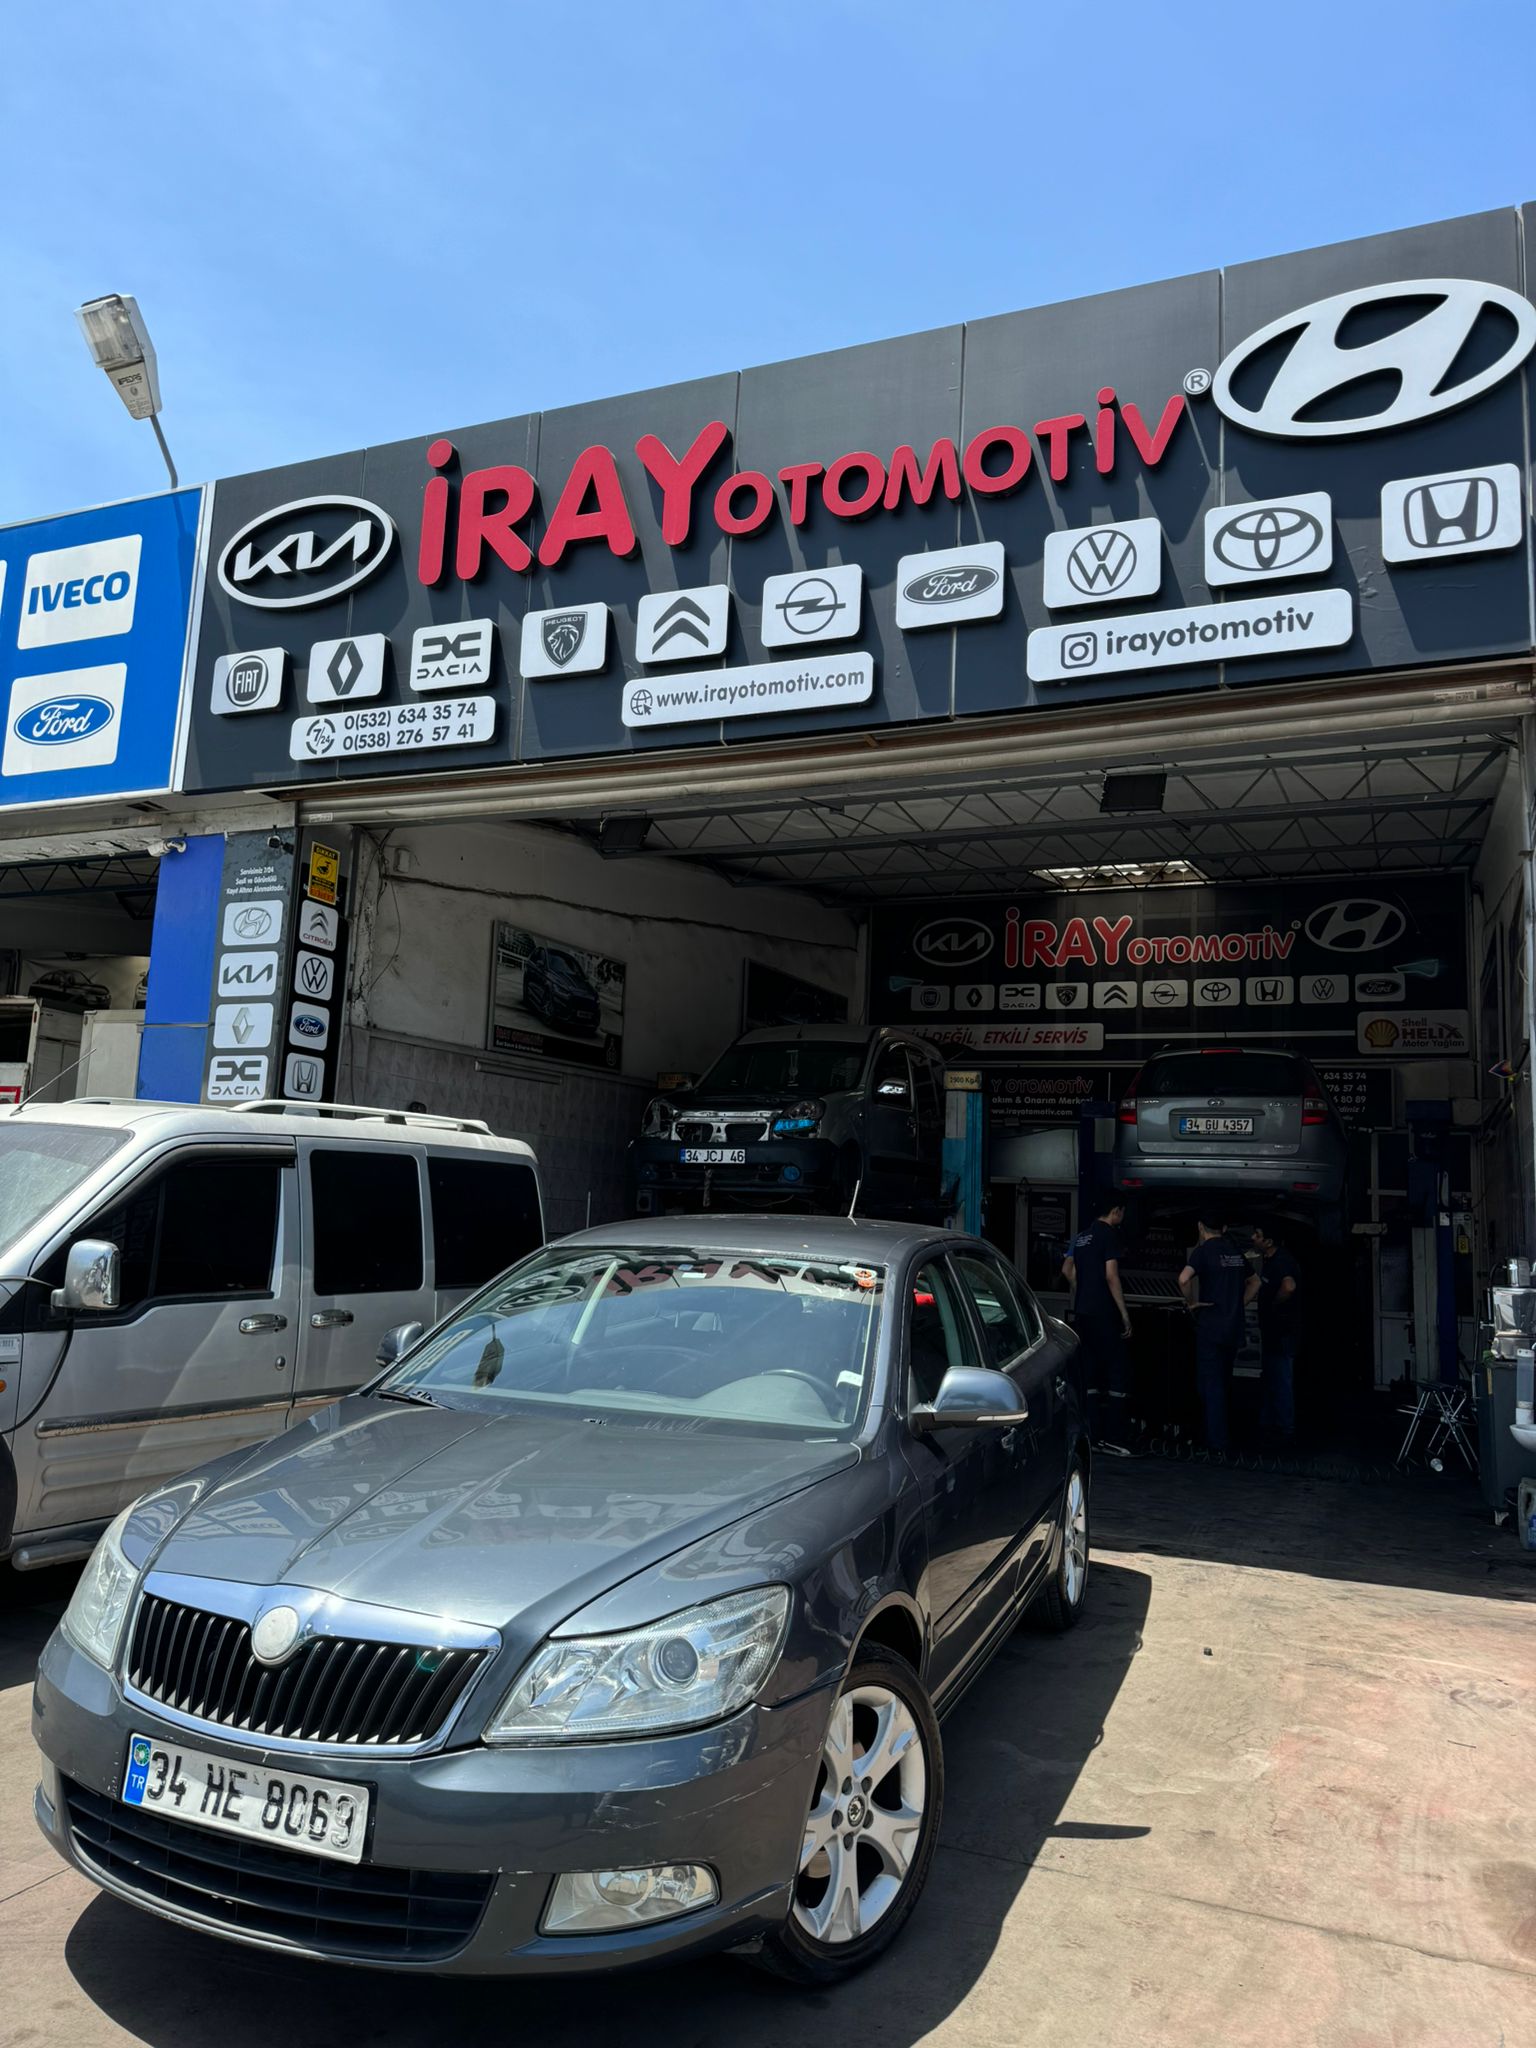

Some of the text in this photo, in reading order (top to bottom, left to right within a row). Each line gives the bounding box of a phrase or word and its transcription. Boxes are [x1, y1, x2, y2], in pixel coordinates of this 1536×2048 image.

[923, 566, 978, 599] Ford
[28, 571, 131, 615] IVECO
[545, 616, 584, 626] PEUGEOT
[1107, 607, 1315, 656] irayotomotiv
[417, 661, 483, 680] DACIA
[235, 668, 260, 694] FIAT
[657, 669, 865, 709] www.irayotomotiv.com
[33, 703, 92, 738] Ford
[344, 702, 477, 730] 0(532) 634 35 74
[343, 723, 475, 750] 0(538) 276 57 41
[1366, 981, 1394, 994] Ford
[299, 1018, 320, 1034] Ford
[1402, 1017, 1427, 1026] Shell
[983, 1028, 1030, 1044] ETKİLİ
[1032, 1027, 1088, 1044] SERVİS
[1402, 1024, 1463, 1039] HELIX
[1402, 1040, 1429, 1048] Motor
[211, 1086, 261, 1096] DACIA
[1326, 1084, 1340, 1092] 76
[992, 1096, 1013, 1104] akım
[1187, 1119, 1250, 1130] 34 GU 4357
[686, 1150, 744, 1162] 34 JCJ 46
[131, 1774, 145, 1788] TR
[147, 1751, 357, 1849] 34 HE 8069
